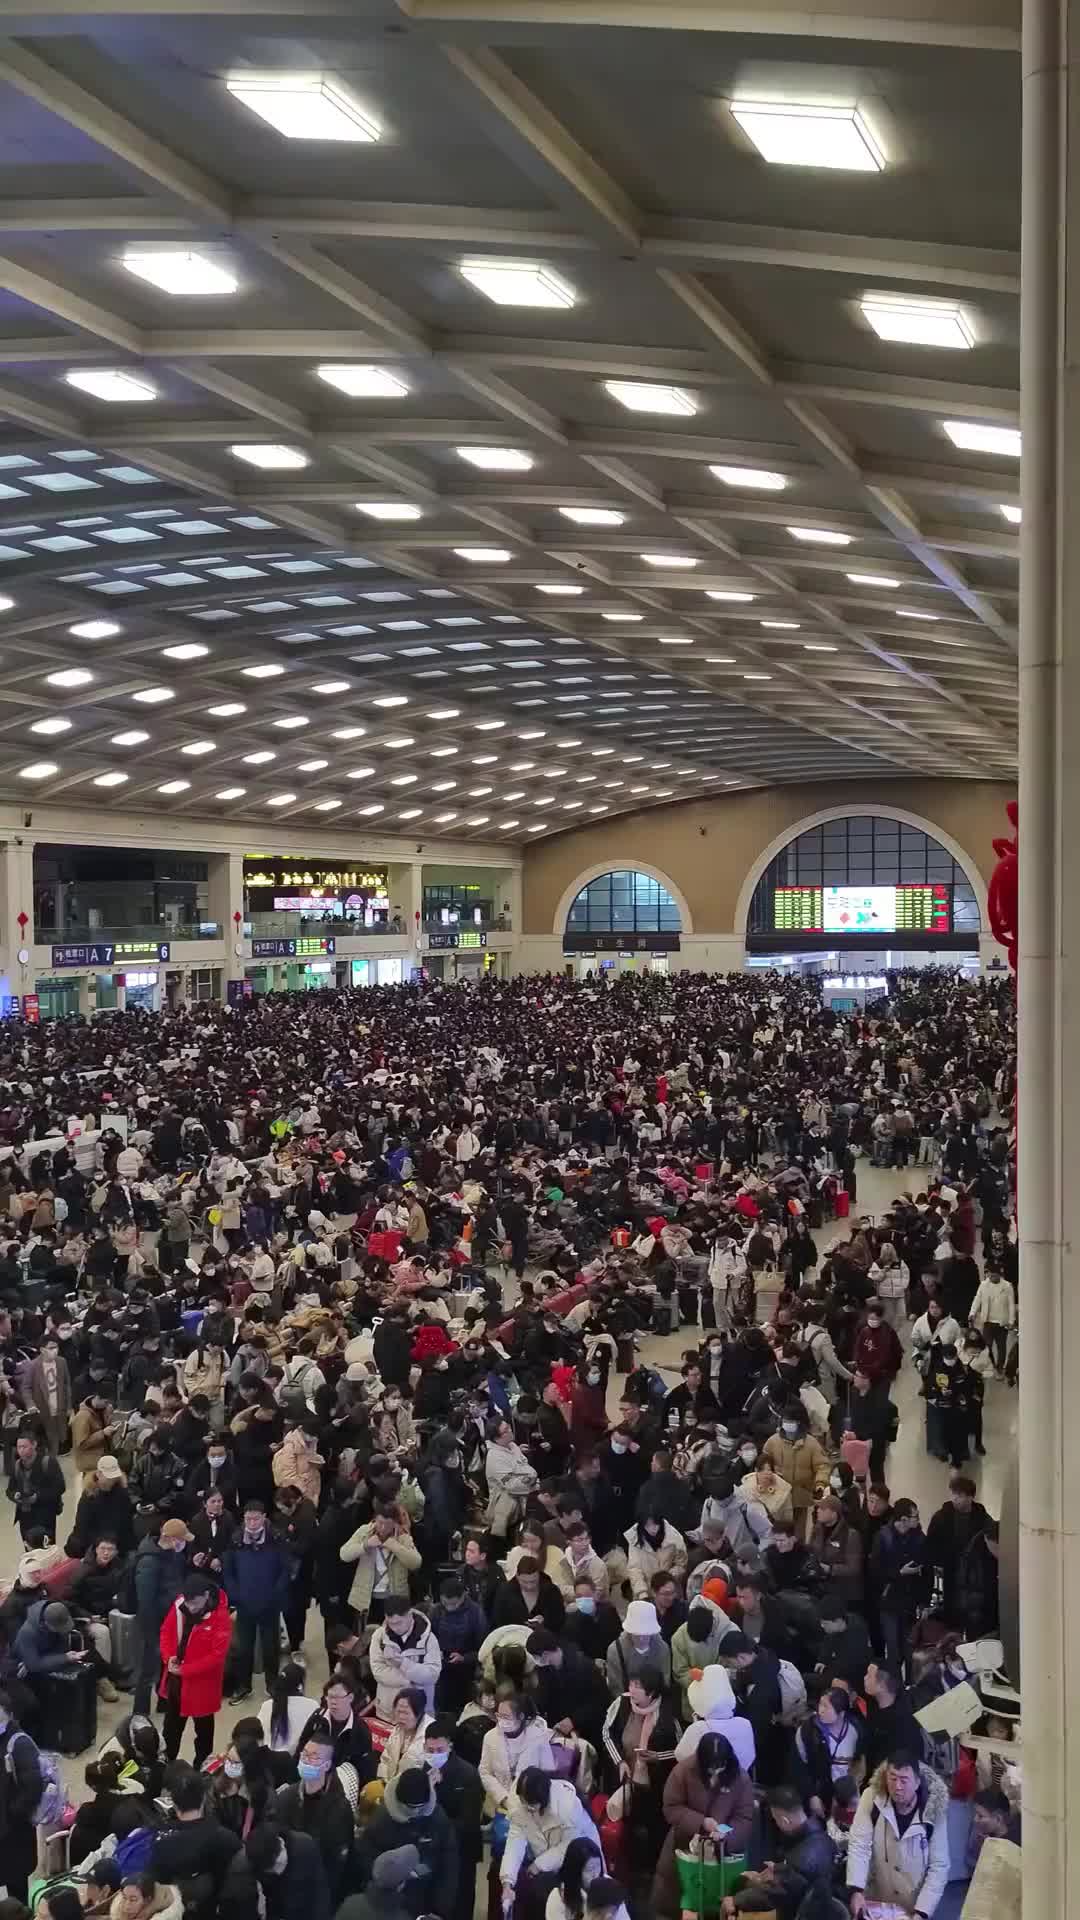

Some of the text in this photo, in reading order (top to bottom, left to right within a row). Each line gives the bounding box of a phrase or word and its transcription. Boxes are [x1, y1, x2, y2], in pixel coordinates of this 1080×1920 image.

[328, 940, 334, 951] 4
[481, 935, 486, 945] 2
[160, 946, 168, 959] 6
[279, 943, 285, 953] A
[288, 941, 295, 953] 5
[90, 948, 99, 961] A
[104, 948, 113, 961] 7
